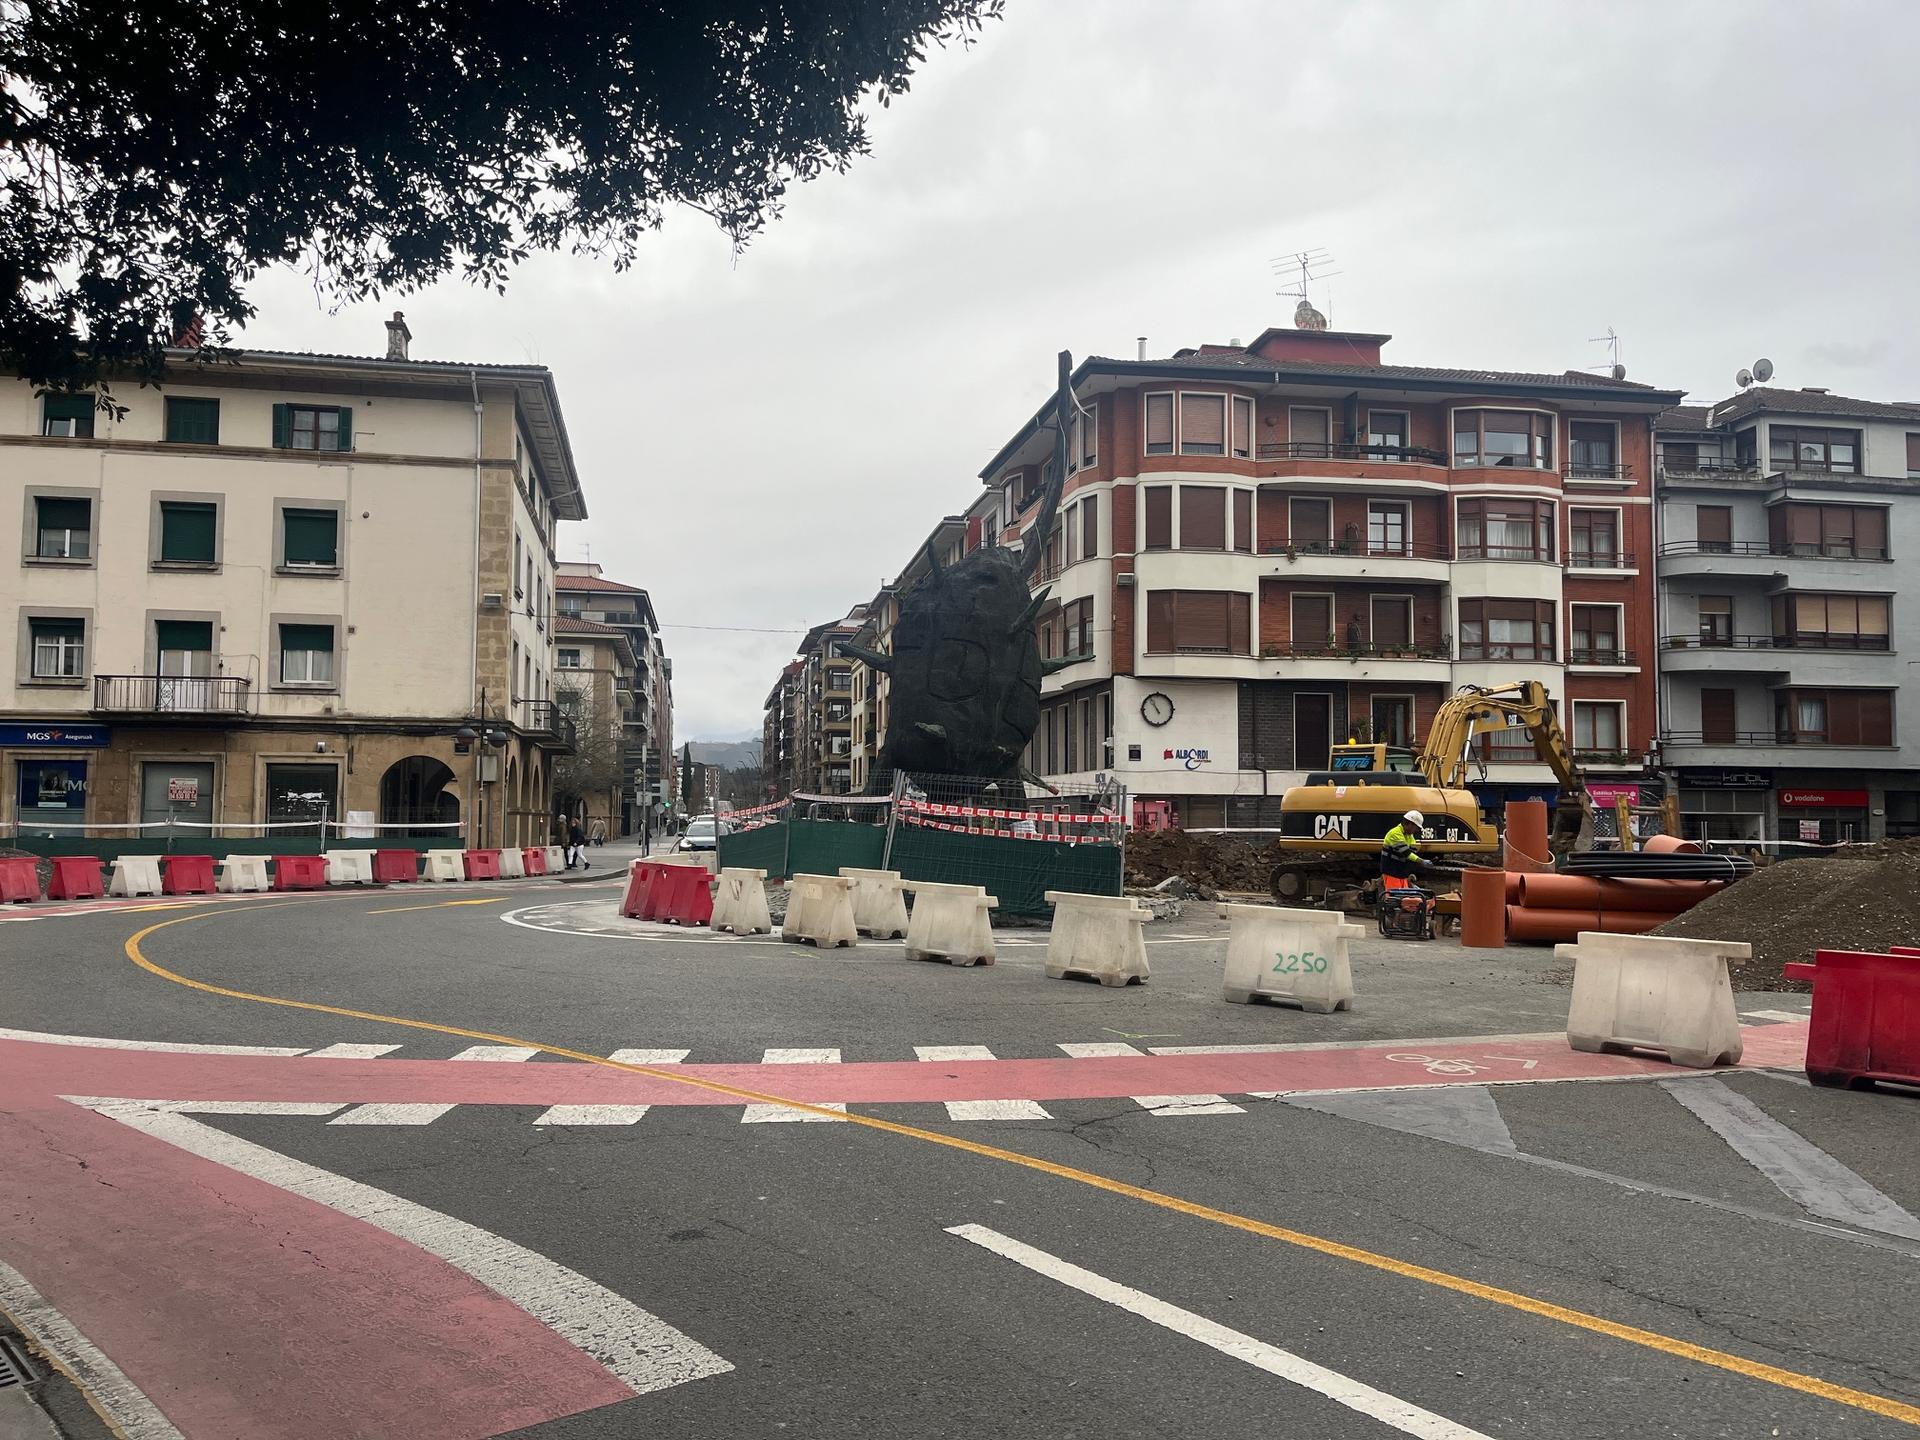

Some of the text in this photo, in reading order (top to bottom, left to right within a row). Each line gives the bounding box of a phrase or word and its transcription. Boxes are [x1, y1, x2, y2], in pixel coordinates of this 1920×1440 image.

[26, 732, 50, 741] MGS
[1314, 814, 1352, 840] CAT
[1446, 828, 1458, 842] CAT
[1272, 951, 1327, 974] 2250
